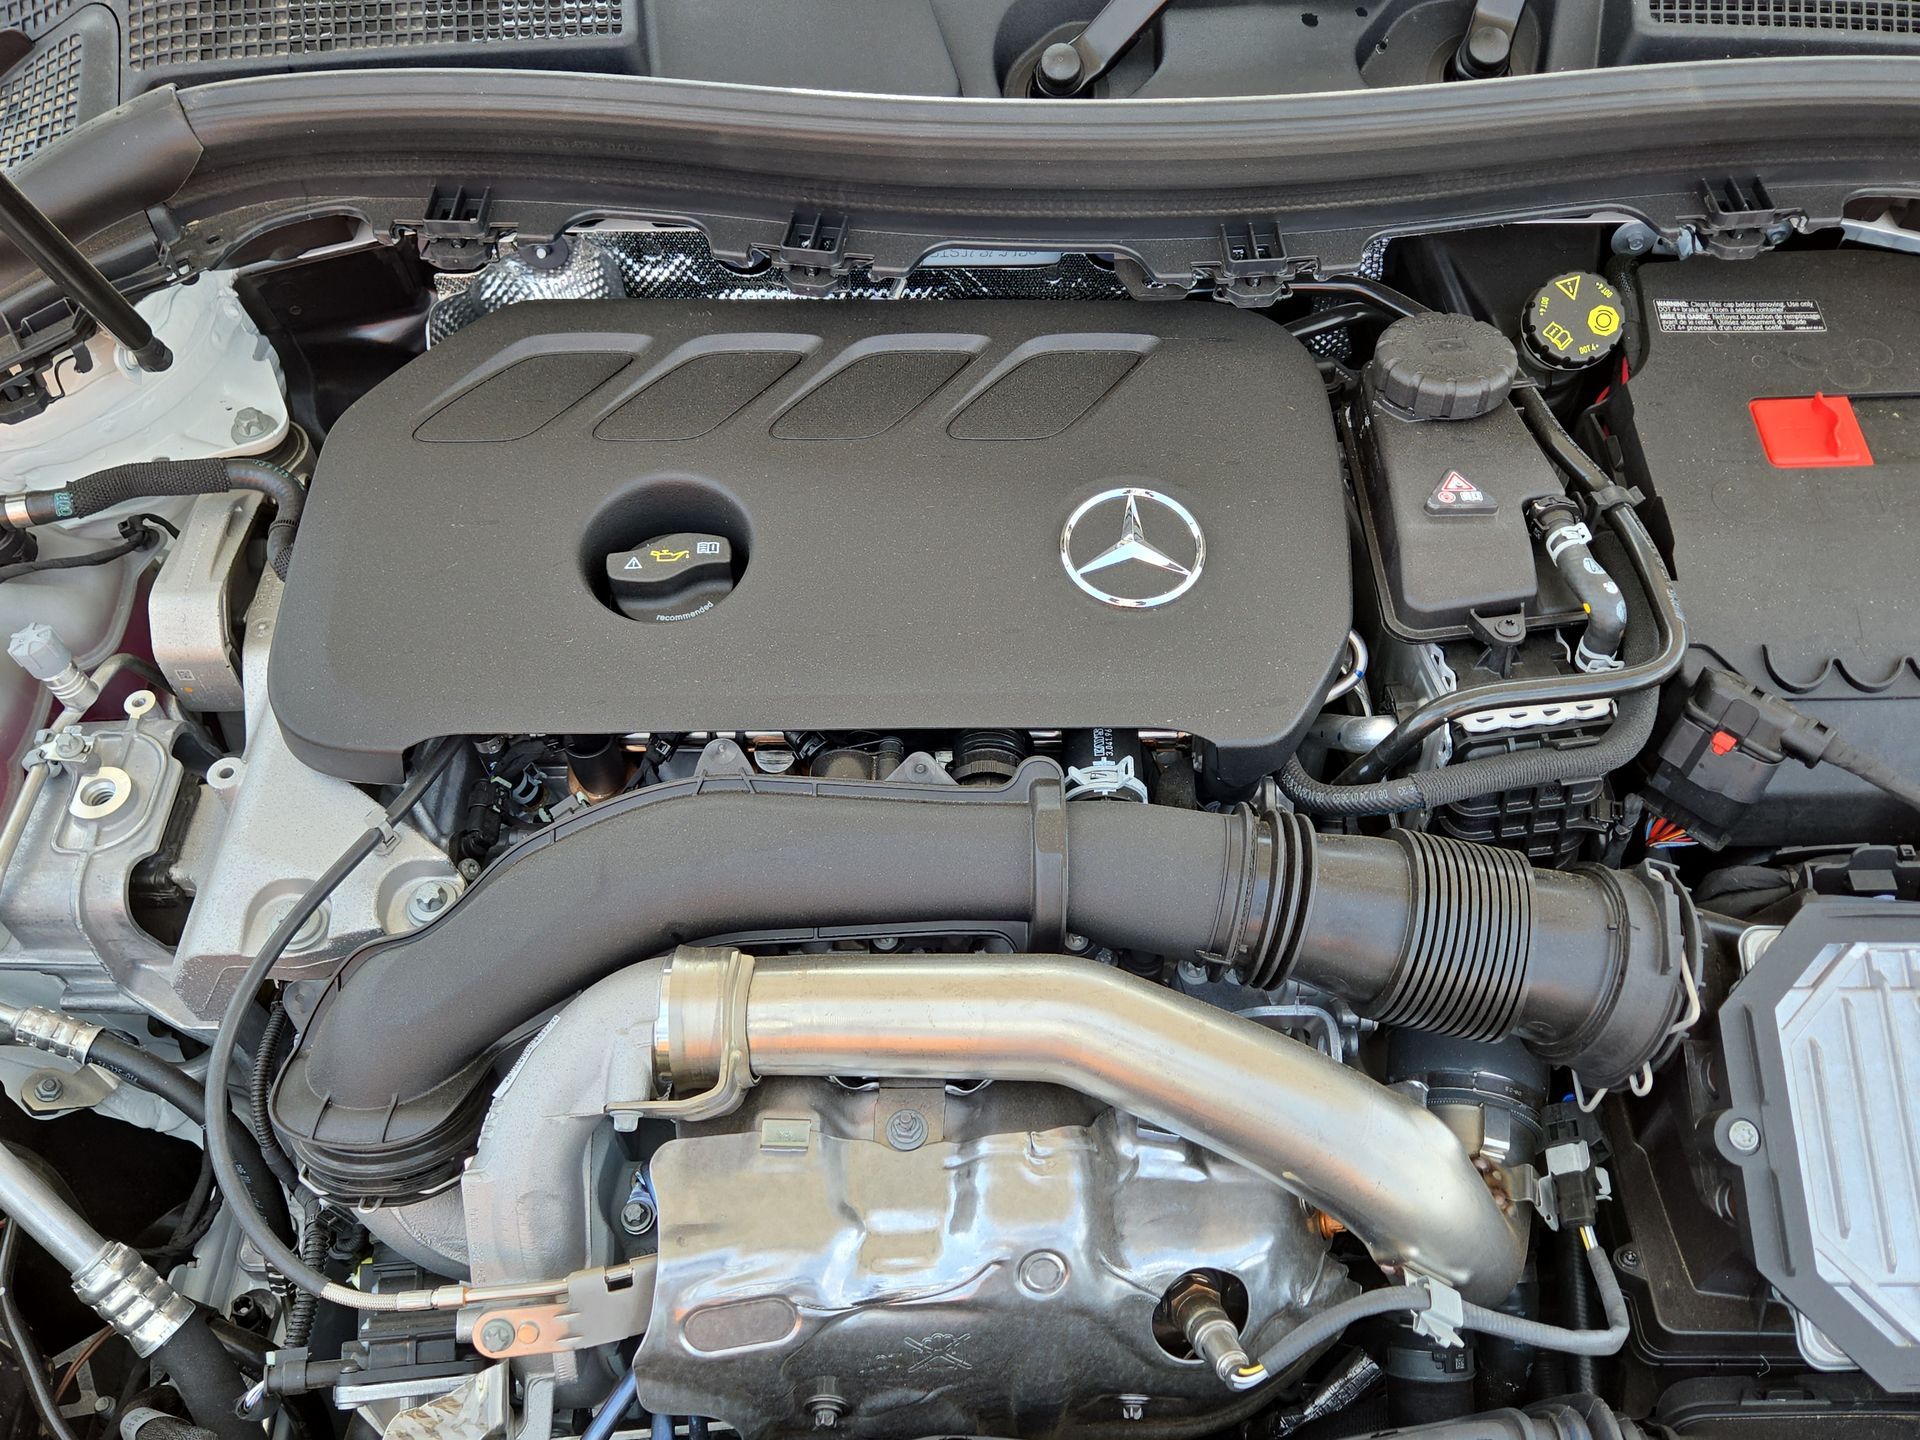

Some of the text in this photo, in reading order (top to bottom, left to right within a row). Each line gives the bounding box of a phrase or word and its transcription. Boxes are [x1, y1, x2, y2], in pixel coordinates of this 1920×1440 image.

[1601, 287, 1613, 298] DOT
[1541, 296, 1549, 308] DOT
[1579, 345, 1591, 355] DOT
[656, 600, 714, 621] recommended
